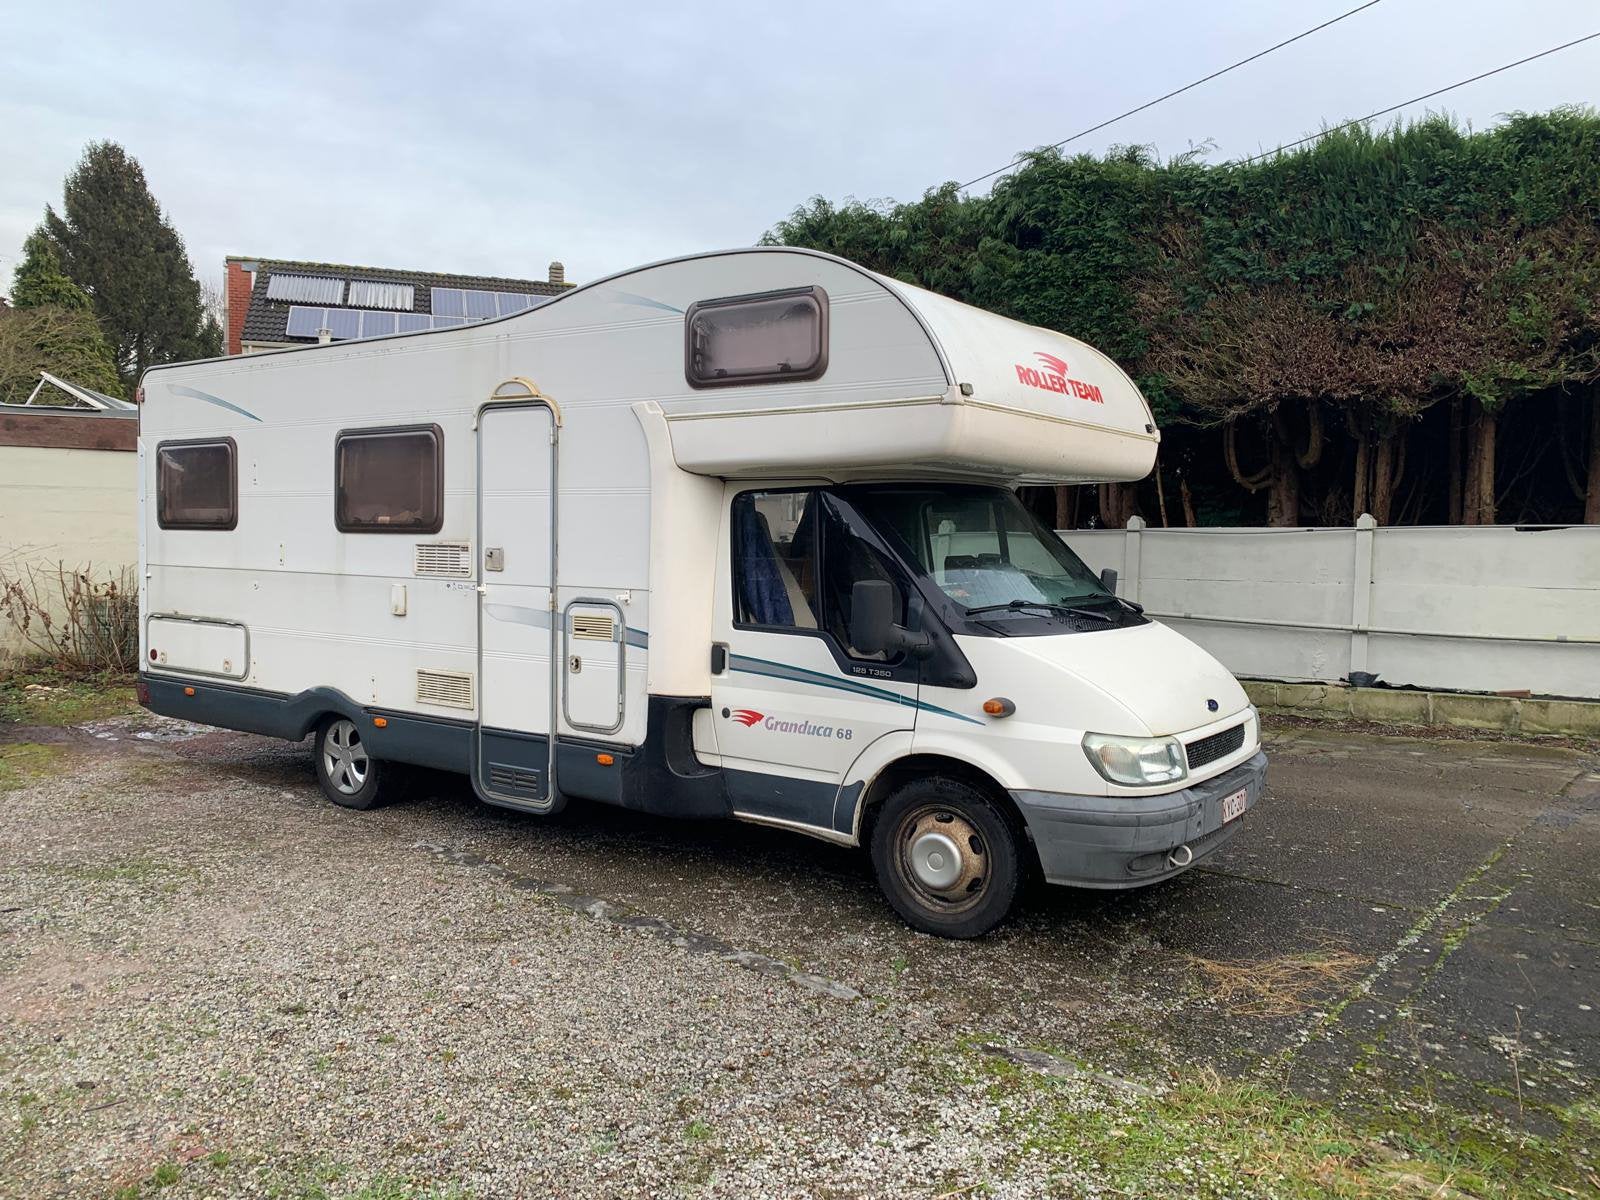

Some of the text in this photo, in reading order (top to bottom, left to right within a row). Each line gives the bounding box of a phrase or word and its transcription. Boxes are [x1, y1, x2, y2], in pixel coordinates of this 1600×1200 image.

[1015, 364, 1104, 404] ROLLER TEAM
[868, 668, 892, 677] T350
[764, 716, 853, 740] Granduca 68
